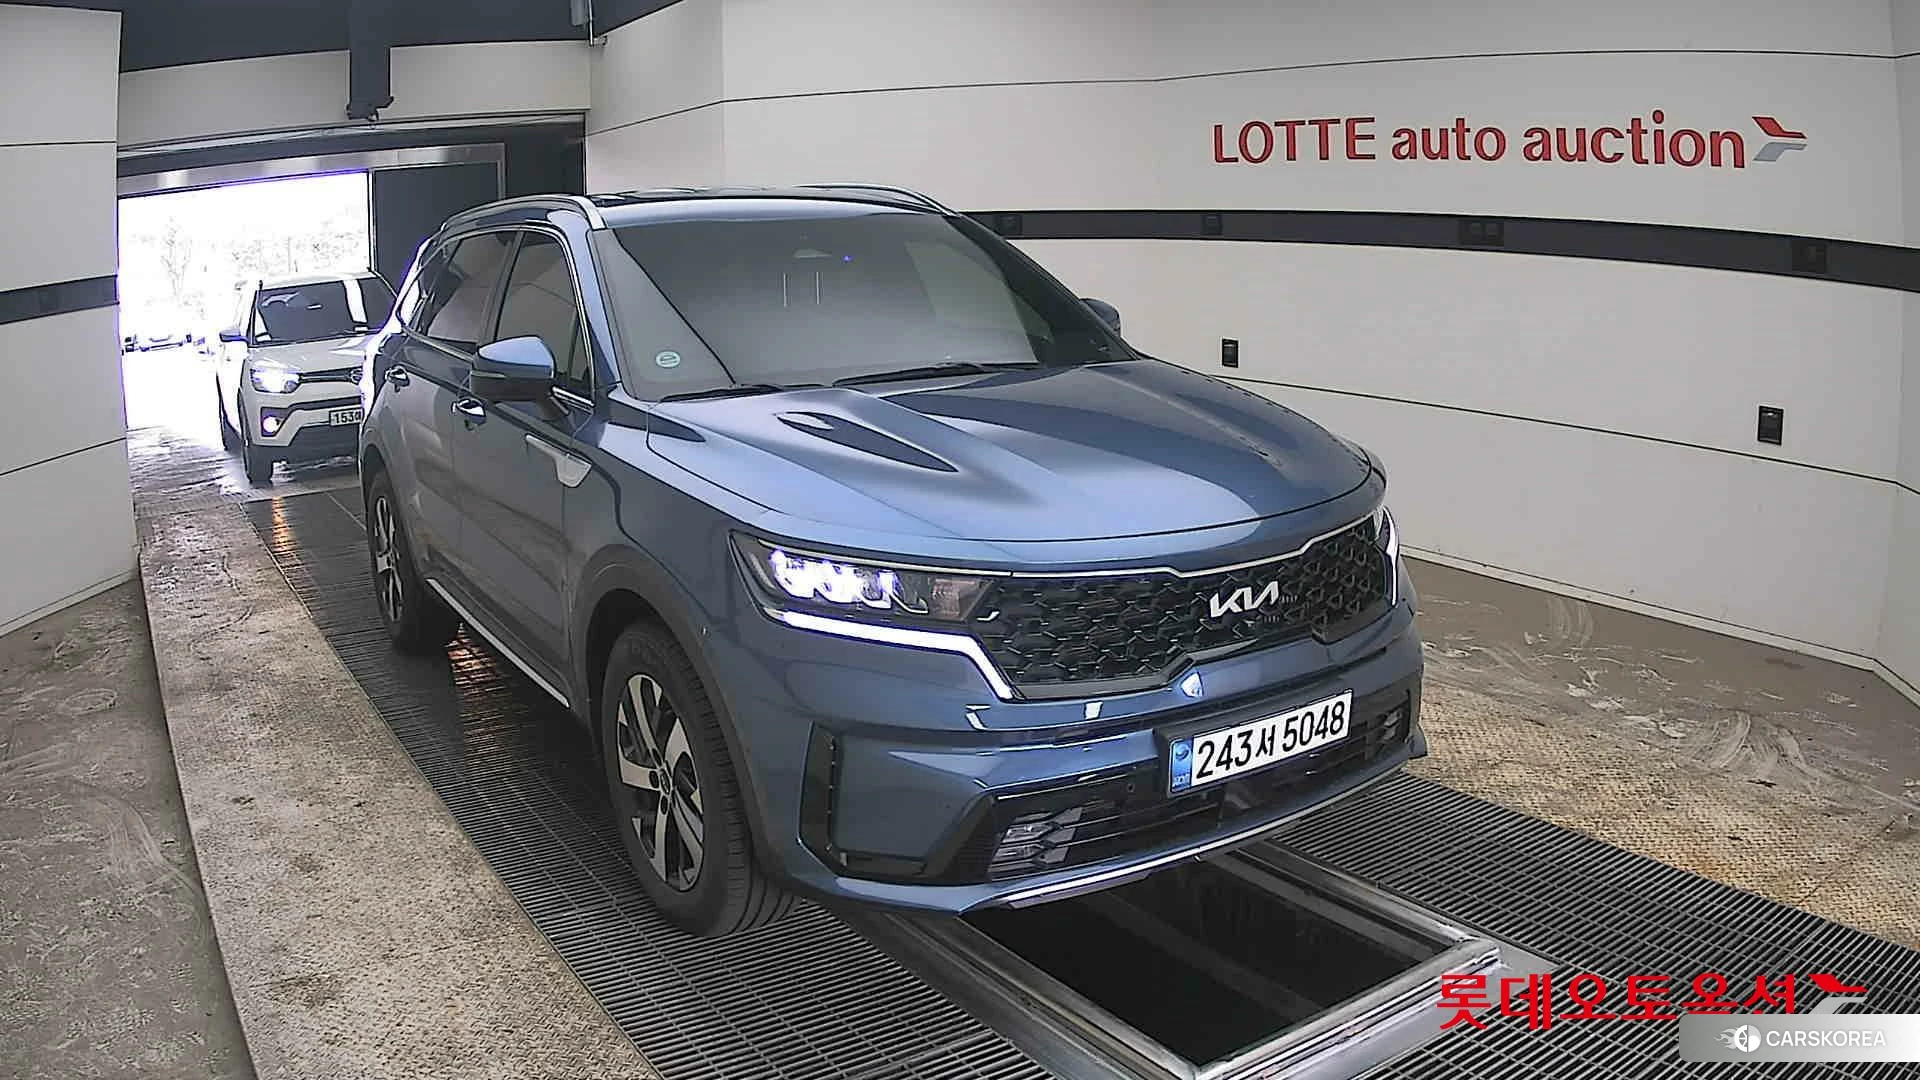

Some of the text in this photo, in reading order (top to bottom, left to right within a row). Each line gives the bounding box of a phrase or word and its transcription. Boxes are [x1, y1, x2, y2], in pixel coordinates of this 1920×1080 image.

[1213, 109, 1746, 169] LOTTE auto auction
